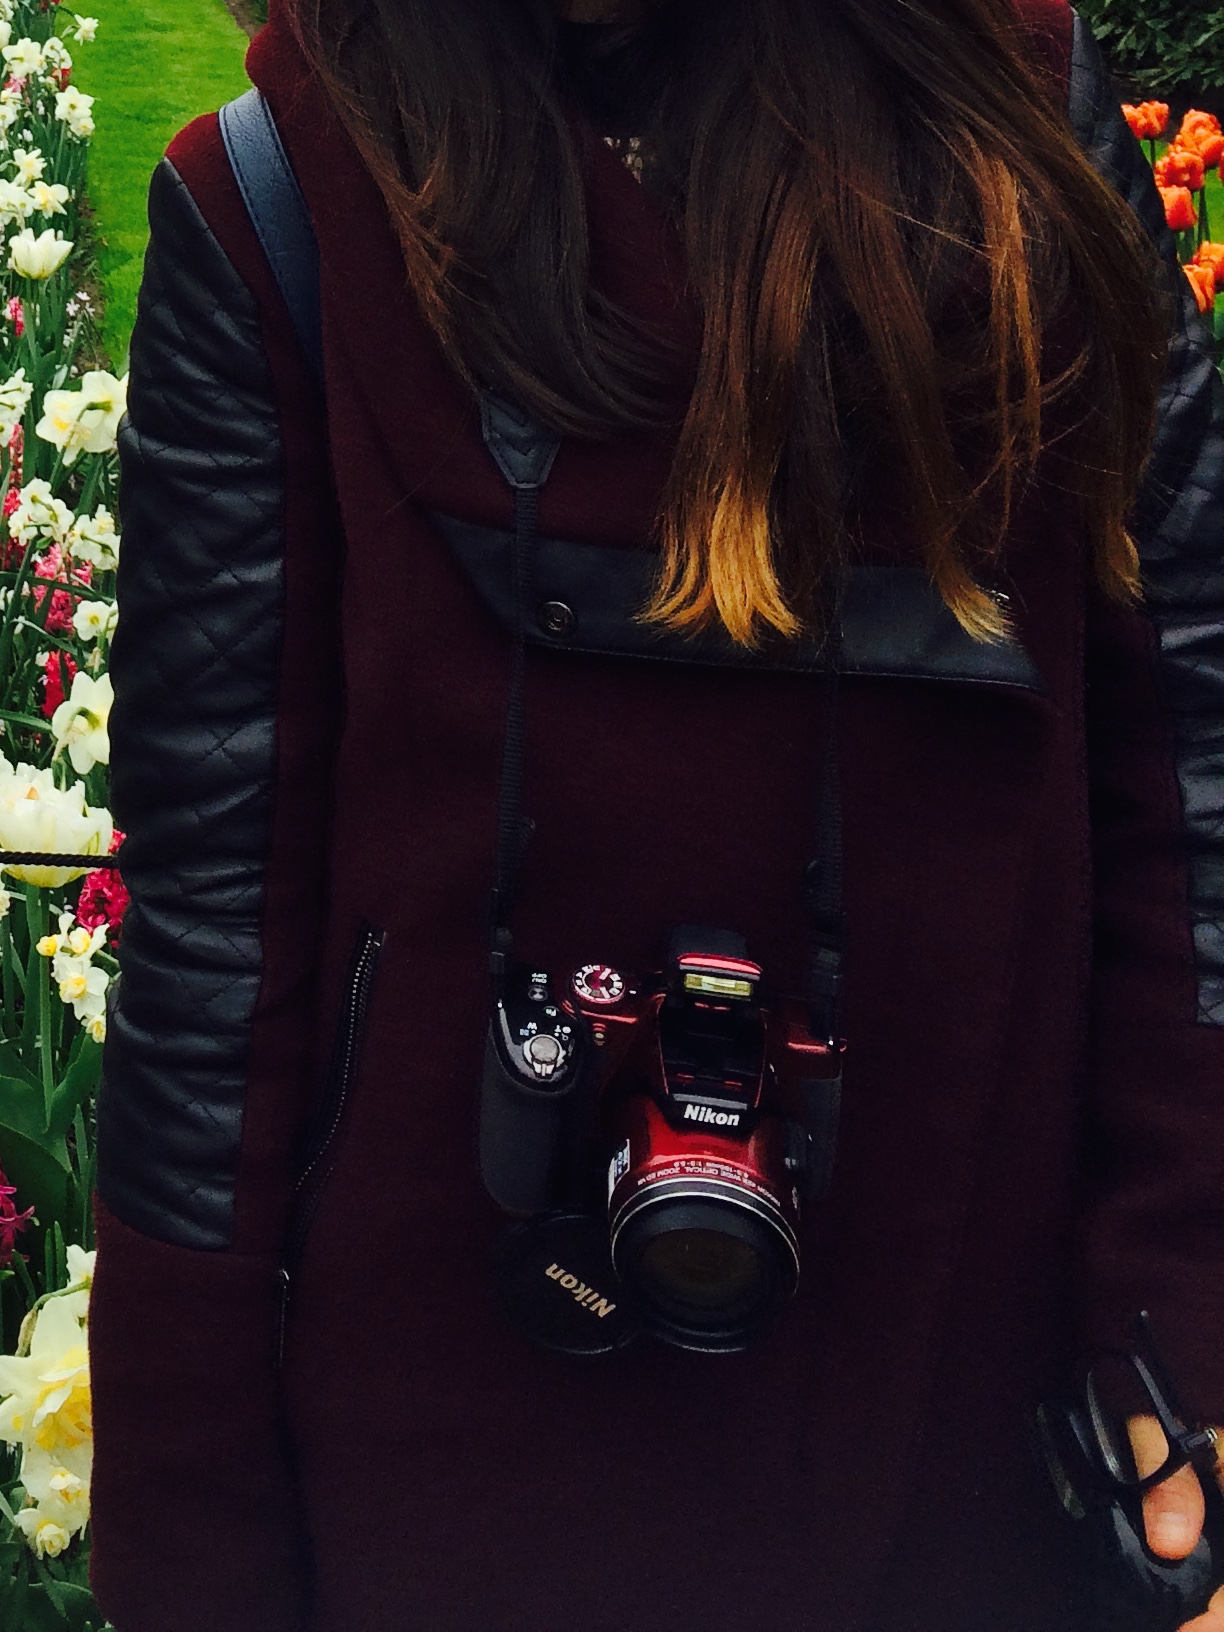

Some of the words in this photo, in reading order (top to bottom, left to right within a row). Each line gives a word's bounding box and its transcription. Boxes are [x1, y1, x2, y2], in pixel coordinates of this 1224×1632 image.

[683, 1103, 741, 1127] Nikon
[656, 1167, 681, 1178] ZOOM
[683, 1166, 719, 1176] OPTICAL
[544, 1262, 617, 1319] Nikon
